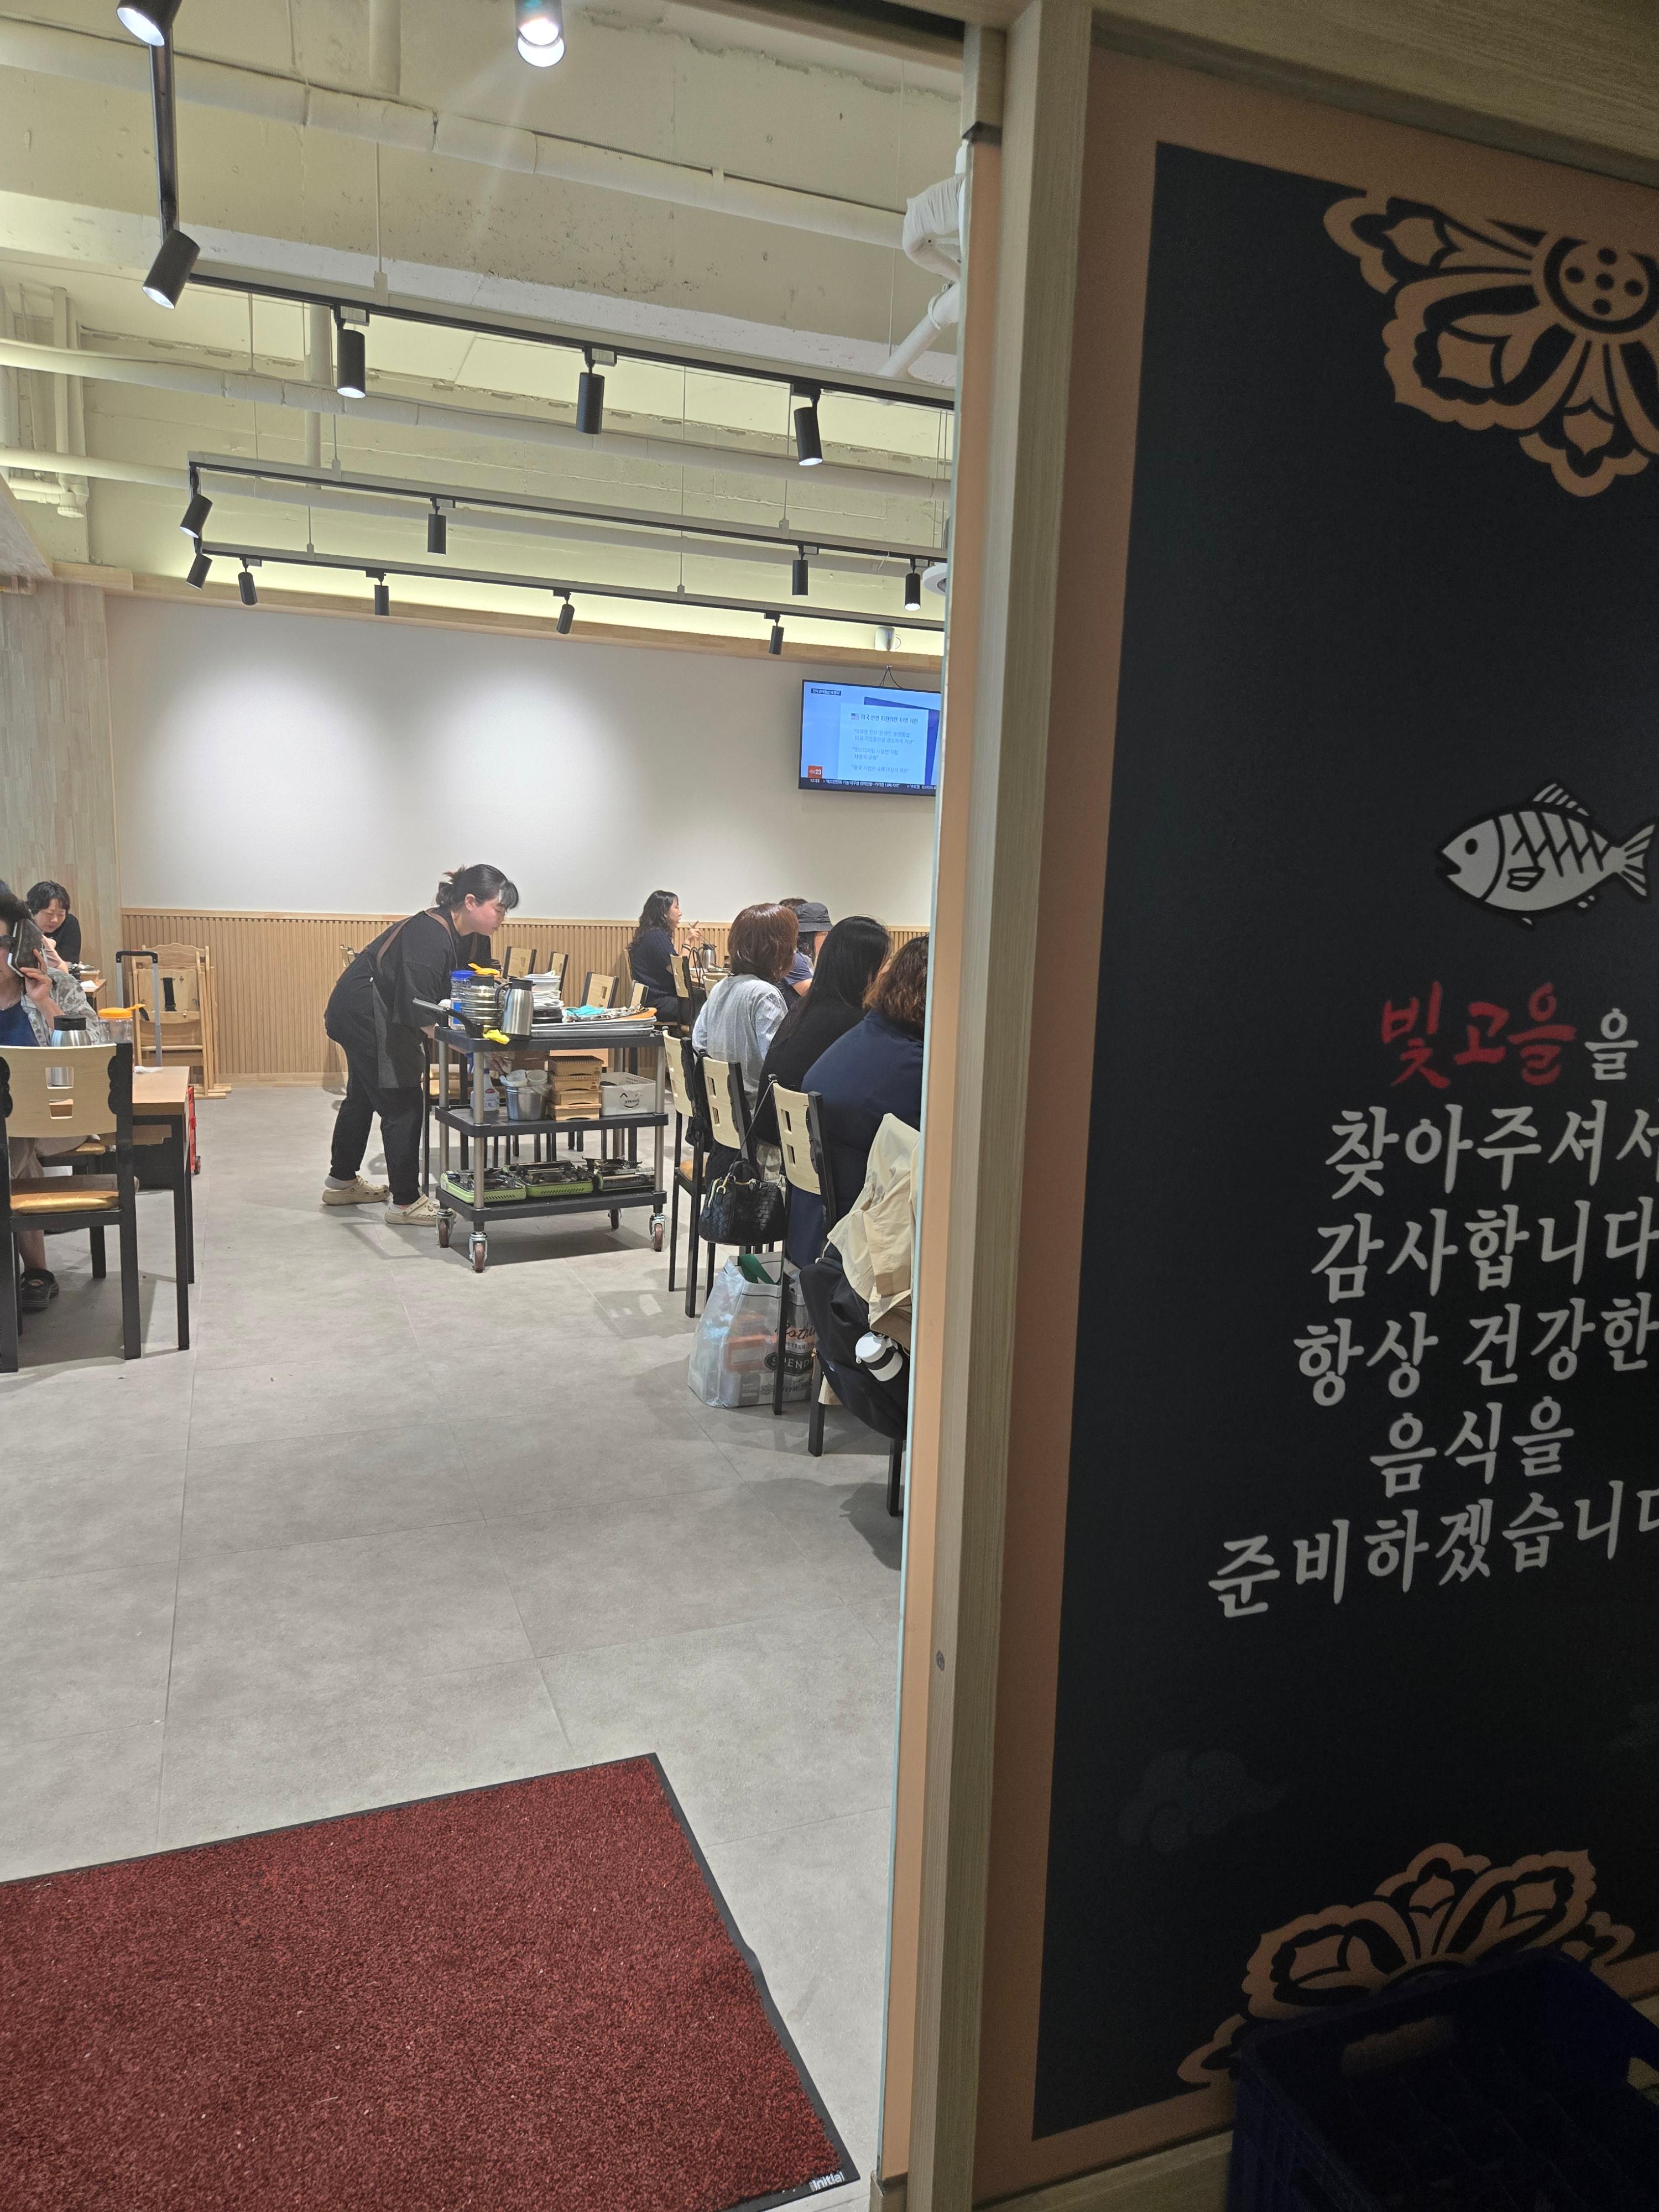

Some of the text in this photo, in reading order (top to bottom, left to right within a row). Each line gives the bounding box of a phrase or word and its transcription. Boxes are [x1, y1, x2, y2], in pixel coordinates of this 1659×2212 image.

[1311, 1196, 1659, 1303] 감사합니다
[1293, 1292, 1659, 1406] 항상 건강한
[1369, 1396, 1574, 1498] 음식을
